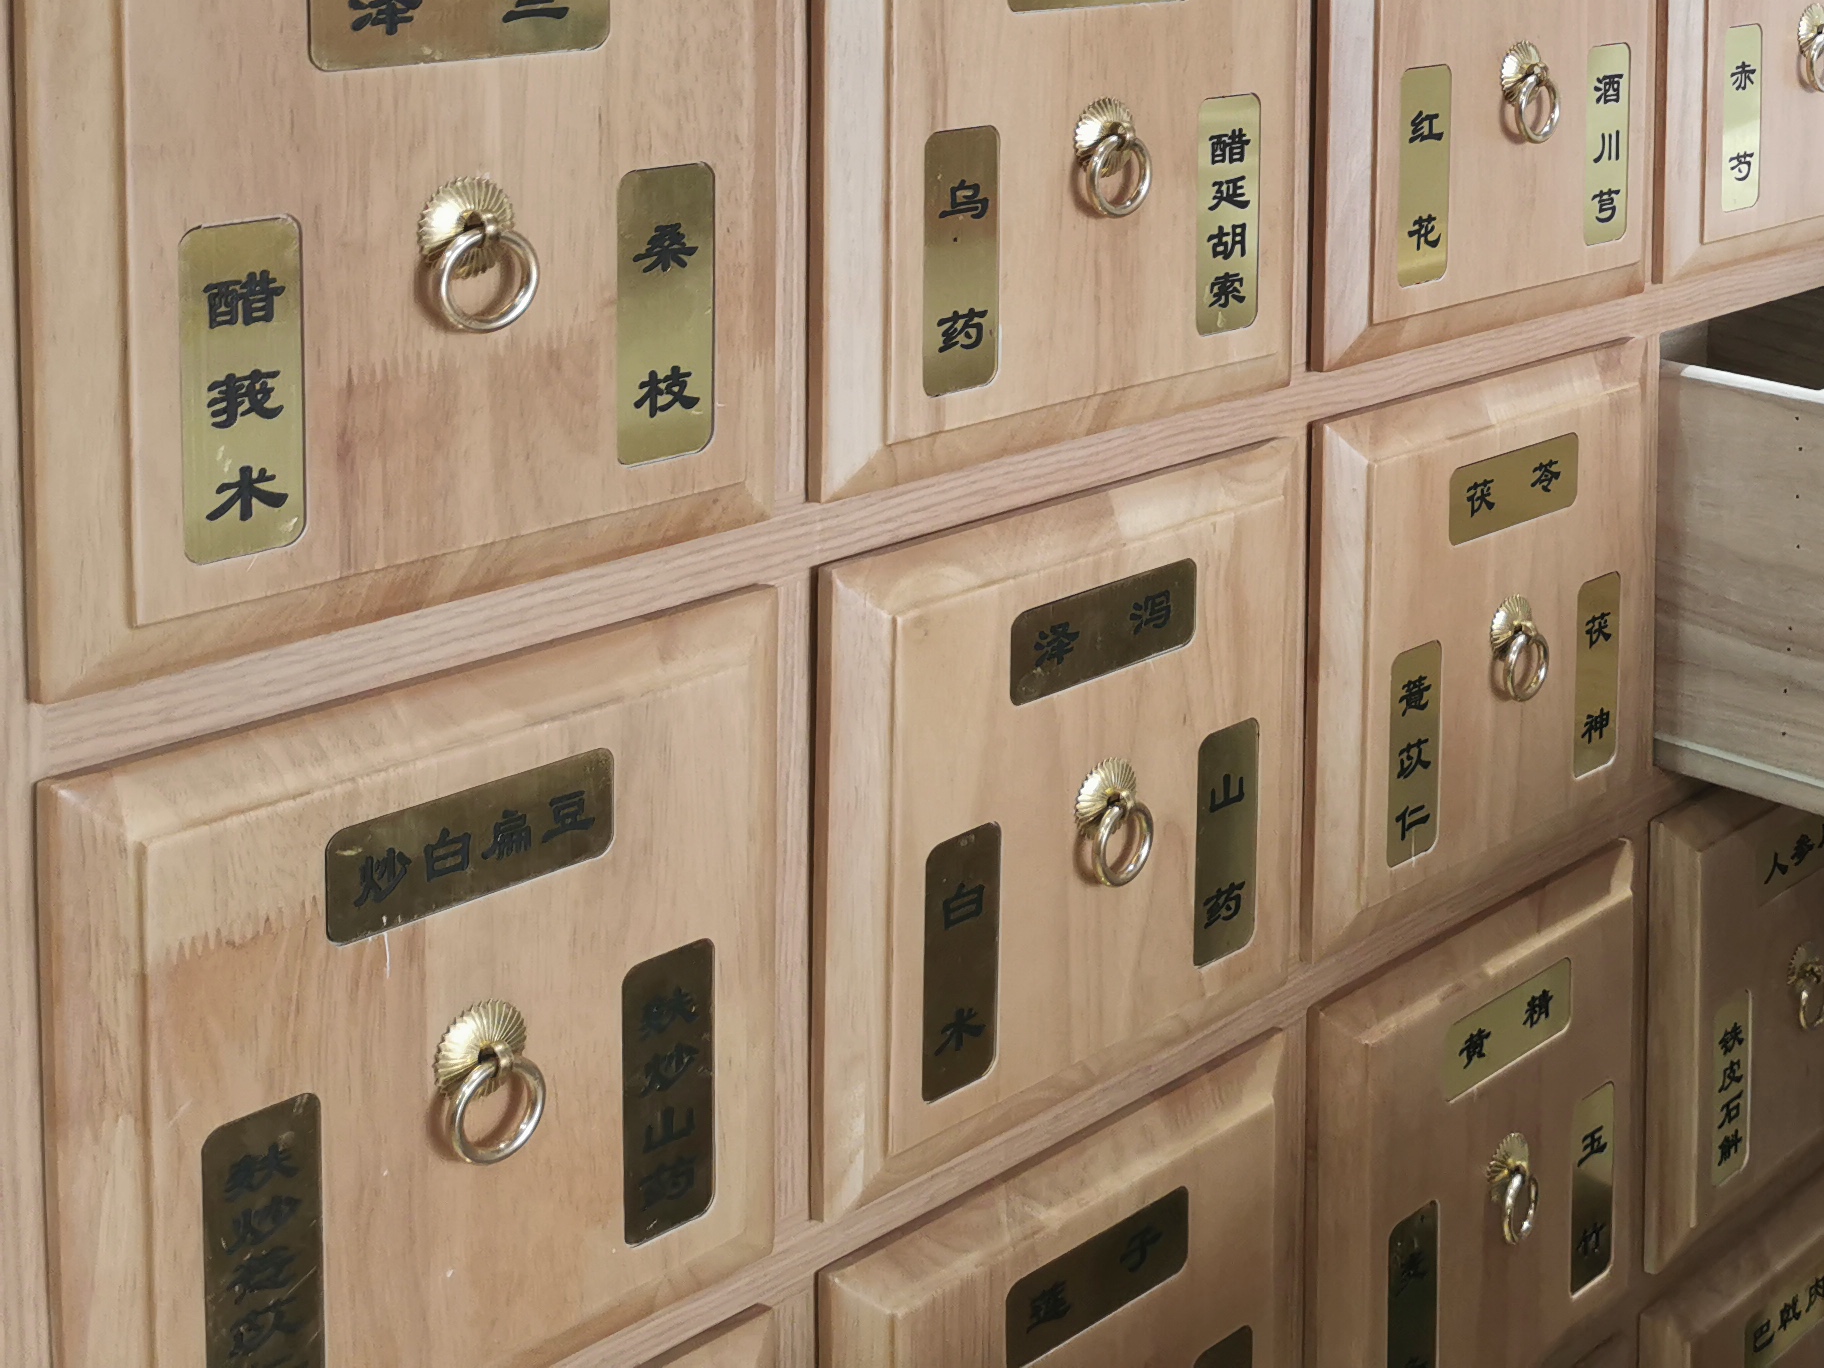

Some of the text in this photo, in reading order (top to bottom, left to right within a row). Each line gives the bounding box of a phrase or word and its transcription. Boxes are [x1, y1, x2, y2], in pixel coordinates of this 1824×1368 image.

[1407, 110, 1443, 251] 红花
[1591, 73, 1624, 223] 酒川芎
[1729, 62, 1756, 182] 赤芍
[937, 179, 988, 353] 乌药
[1206, 128, 1250, 308] 醋延胡索
[633, 223, 700, 417] 桑枝
[202, 268, 287, 522] 醋莪术
[1466, 458, 1562, 518] 茯苓
[1034, 589, 1170, 666] 泽泻
[1581, 611, 1612, 744] 茯神
[1395, 675, 1432, 841] 薏苡仁
[353, 790, 595, 909] 炒白扁豆
[1203, 773, 1245, 930] 山药
[934, 882, 985, 1056] 白术
[1458, 988, 1553, 1069] 黄精
[1577, 1125, 1608, 1258] 玉竹
